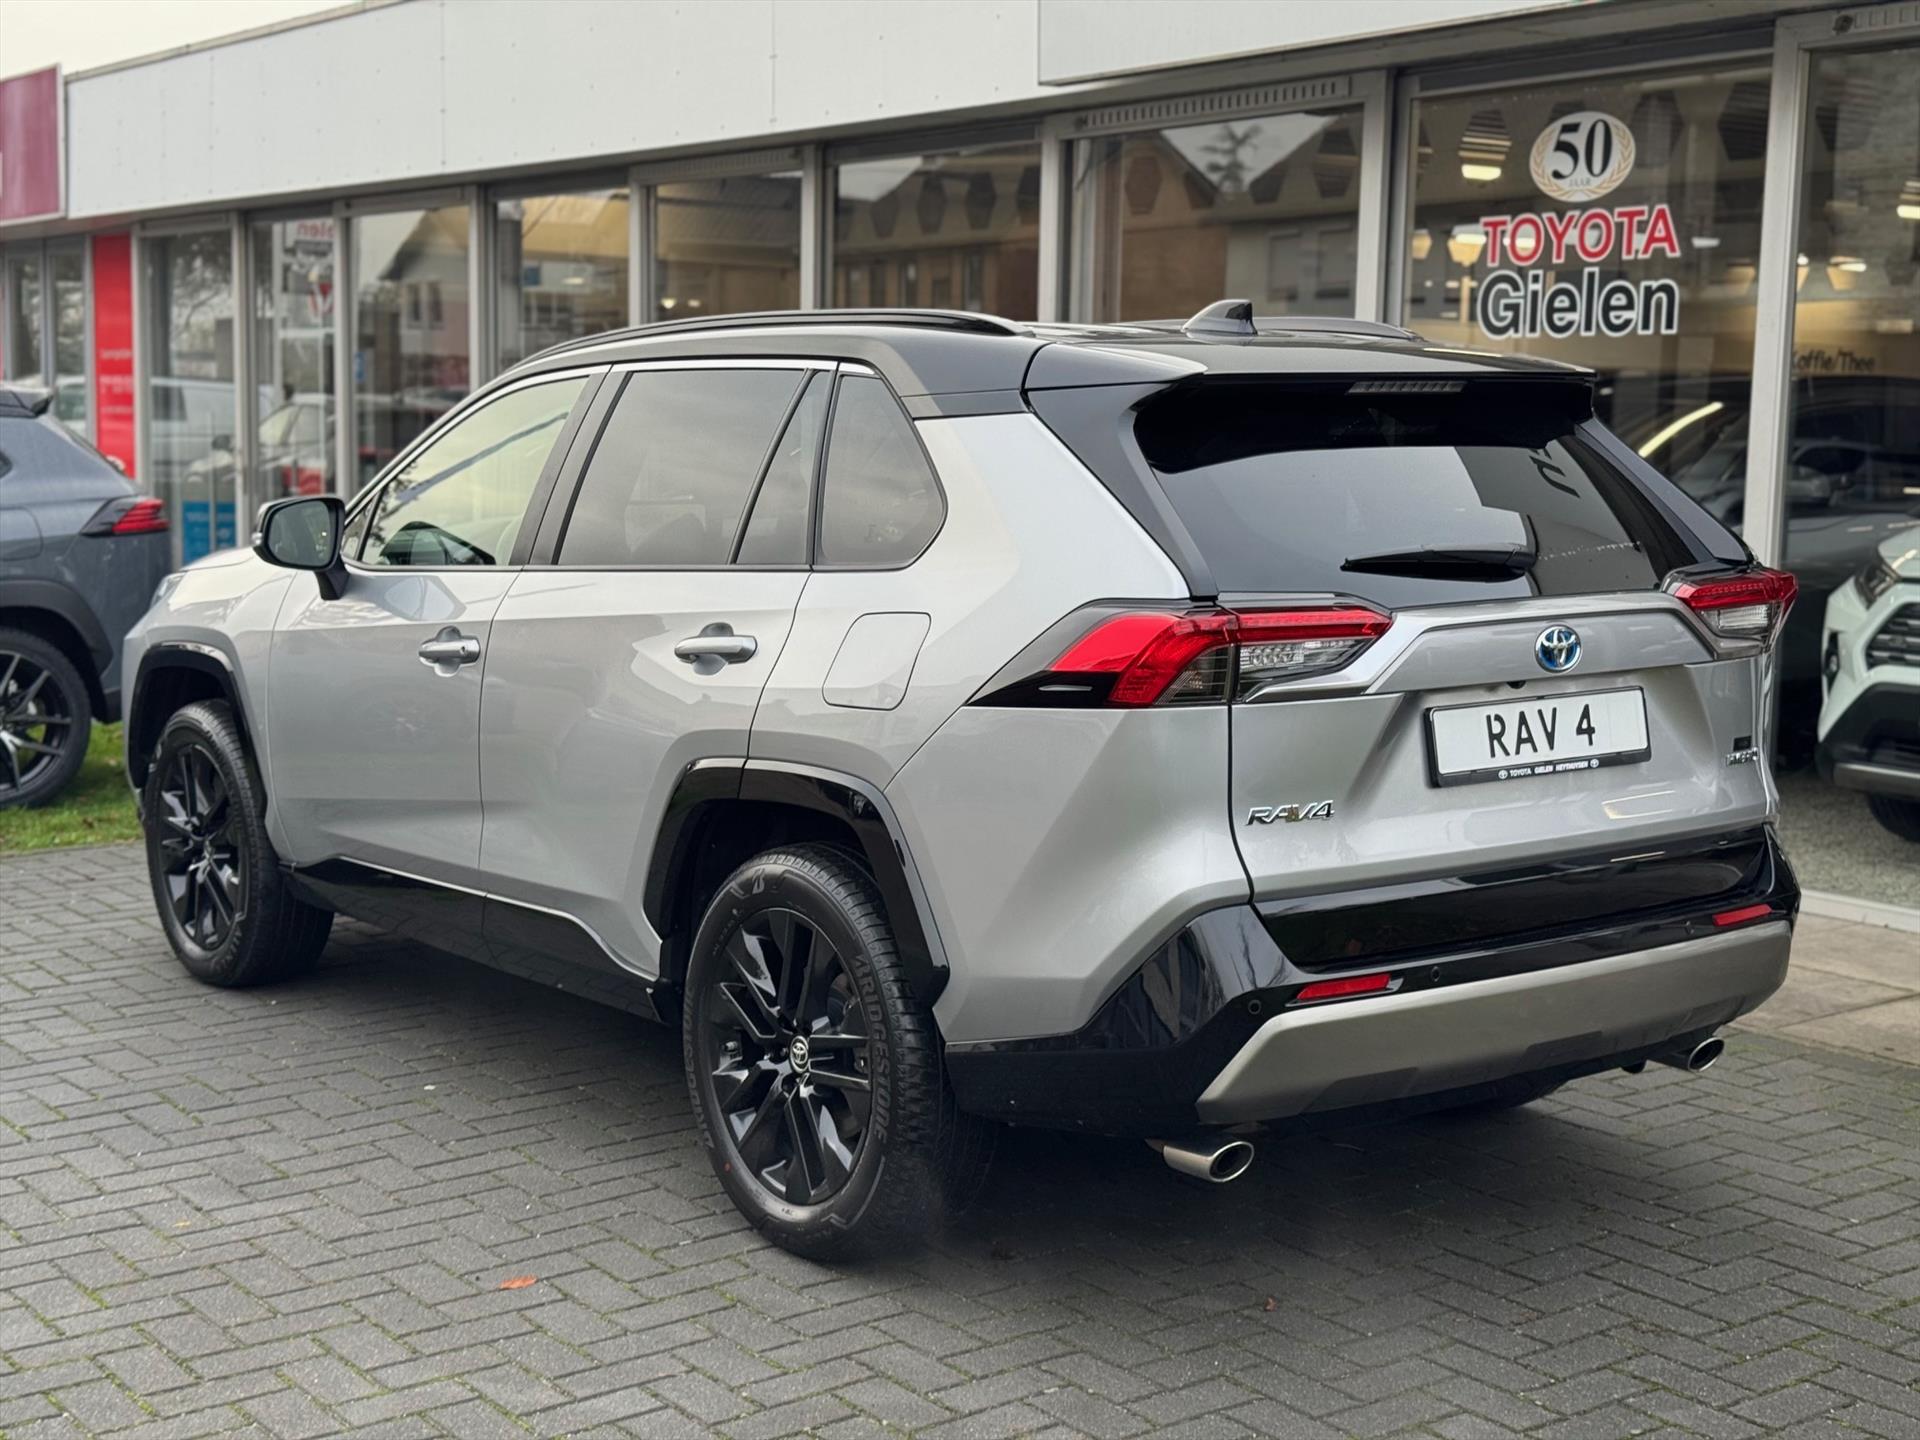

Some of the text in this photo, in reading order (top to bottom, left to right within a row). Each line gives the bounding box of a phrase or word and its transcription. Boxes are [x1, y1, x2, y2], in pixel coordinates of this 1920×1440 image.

[1551, 118, 1613, 180] 50
[1480, 204, 1681, 267] TOYOTA
[1477, 267, 1680, 339] Gielen
[1485, 703, 1595, 758] RAV 4
[1510, 767, 1532, 777] TOYOTA
[1246, 800, 1335, 826] RAV4
[855, 954, 891, 1143] BRIDGESTONE
